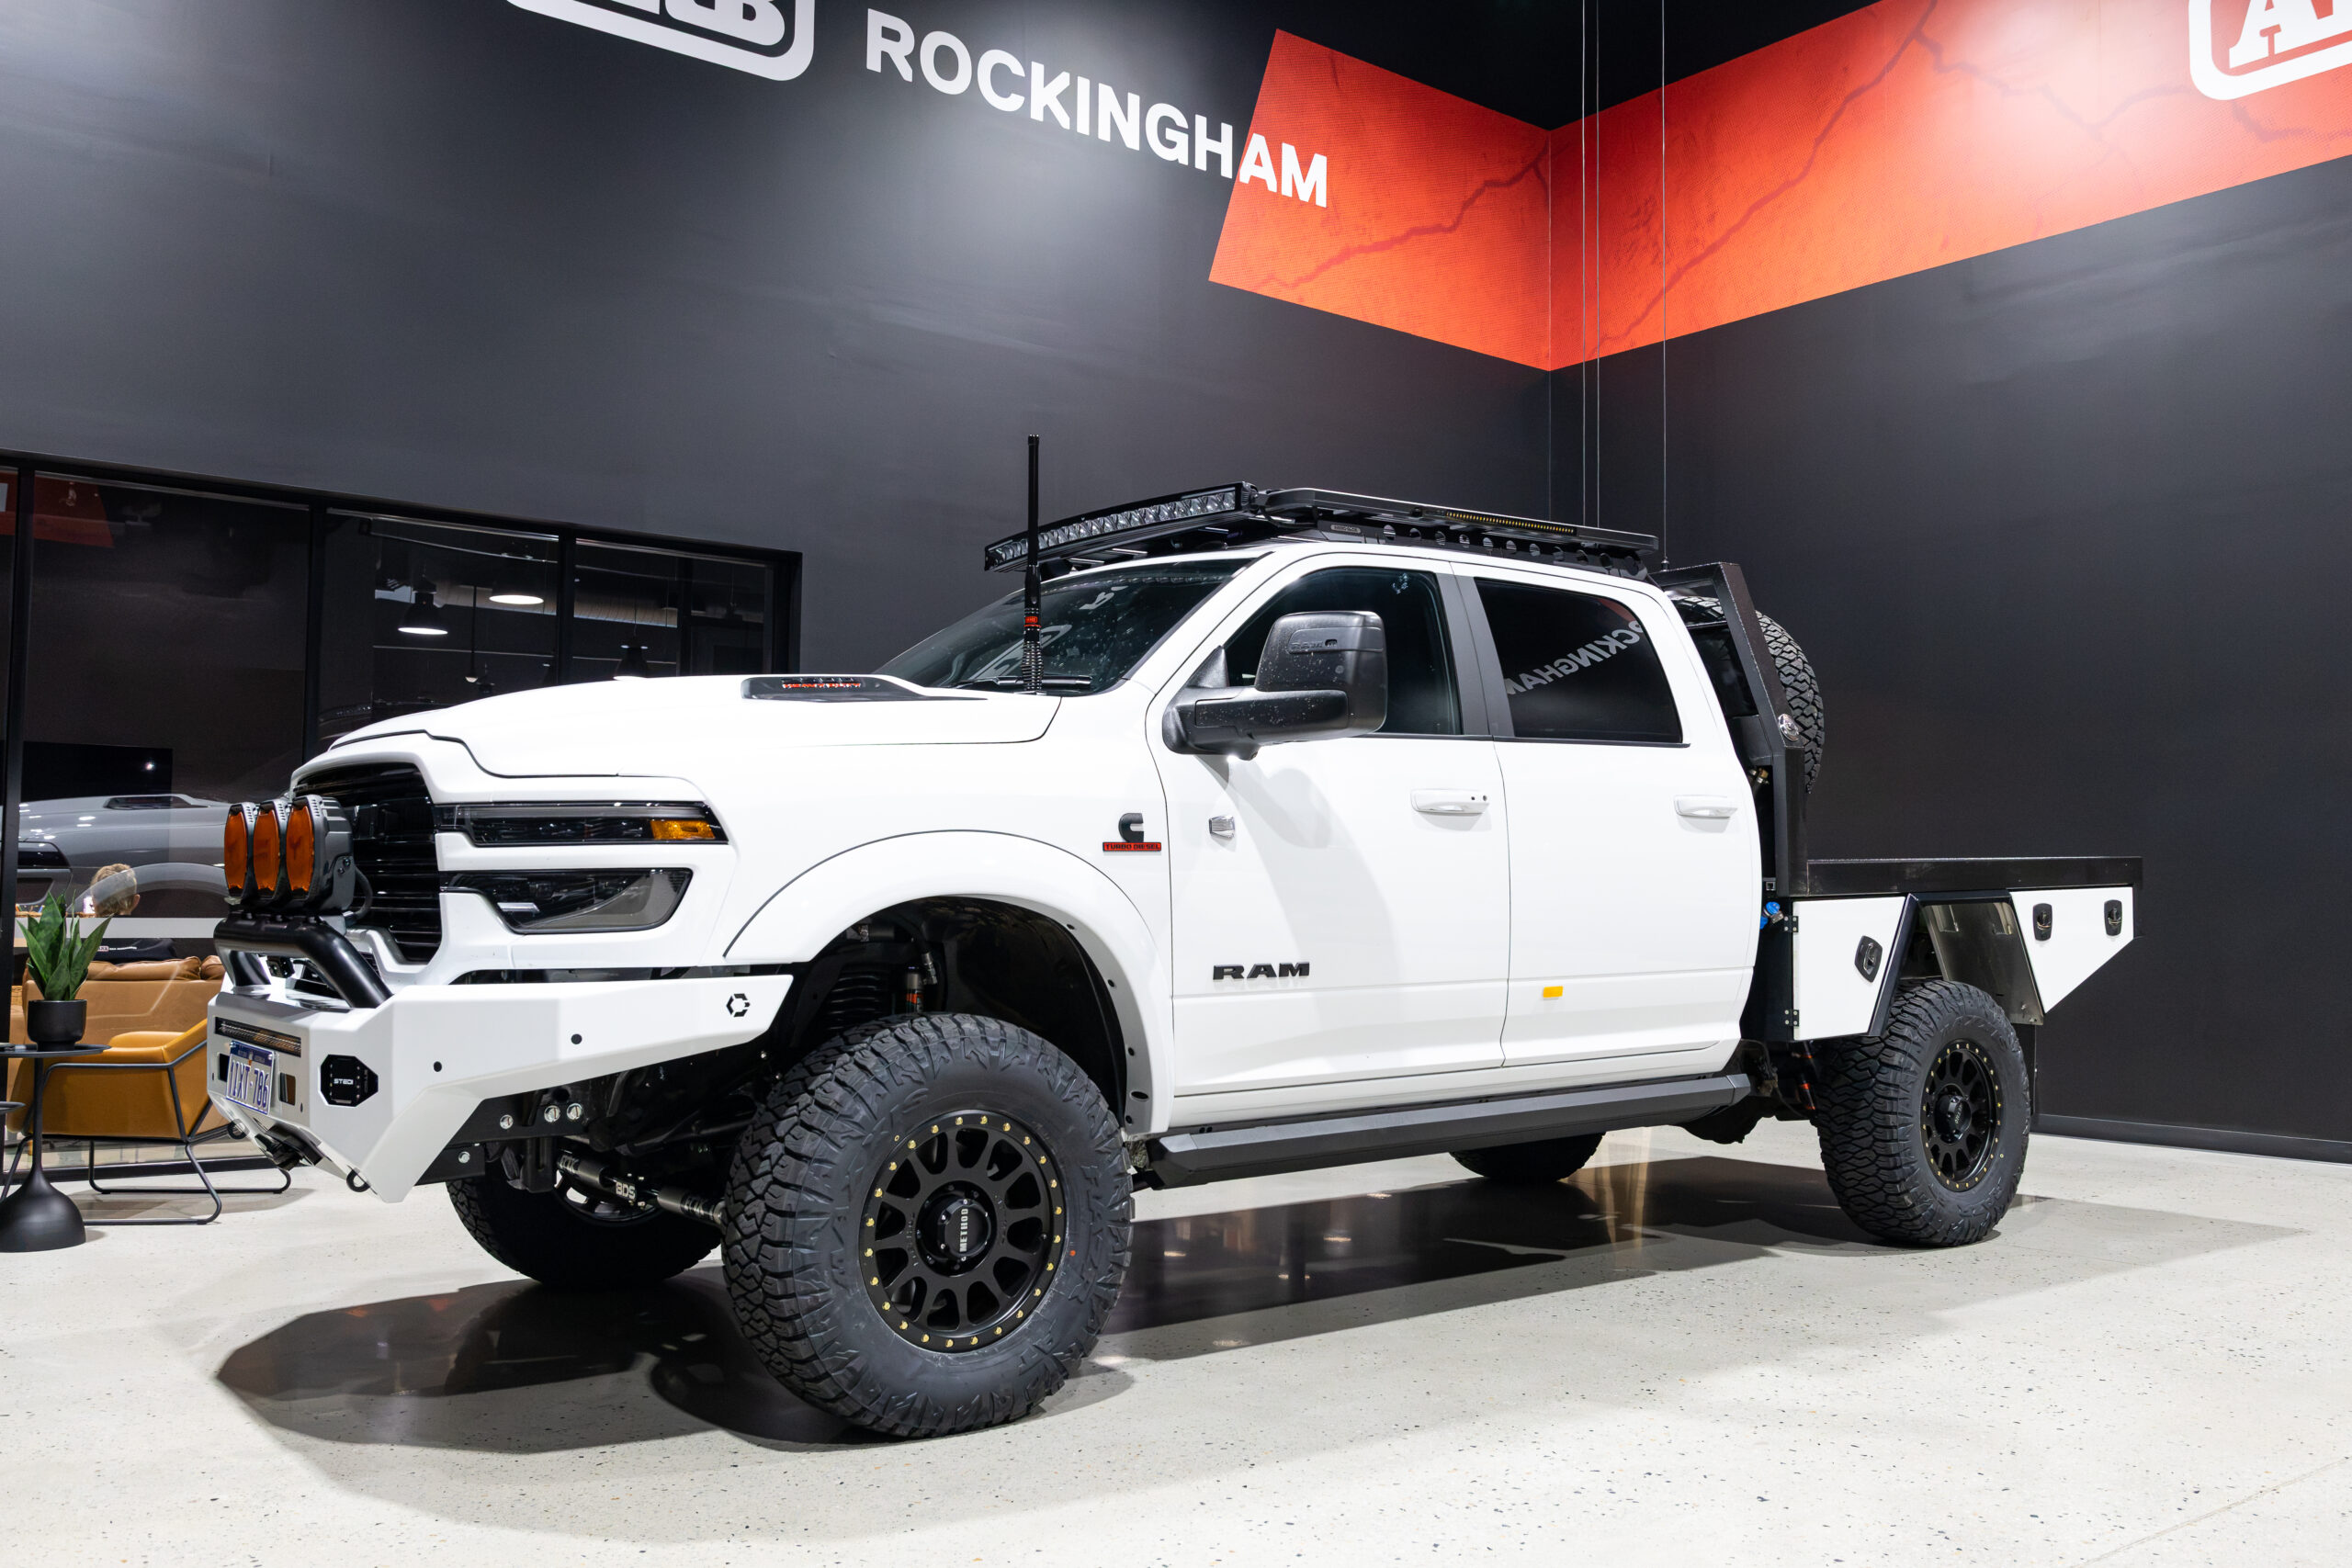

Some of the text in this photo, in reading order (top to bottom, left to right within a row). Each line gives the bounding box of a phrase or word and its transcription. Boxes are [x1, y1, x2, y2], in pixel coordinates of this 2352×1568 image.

[866, 9, 1328, 209] ROCKINGHAM
[1213, 962, 1309, 980] RAM
[616, 1181, 636, 1200] BDS
[959, 1208, 968, 1253] METHOD
